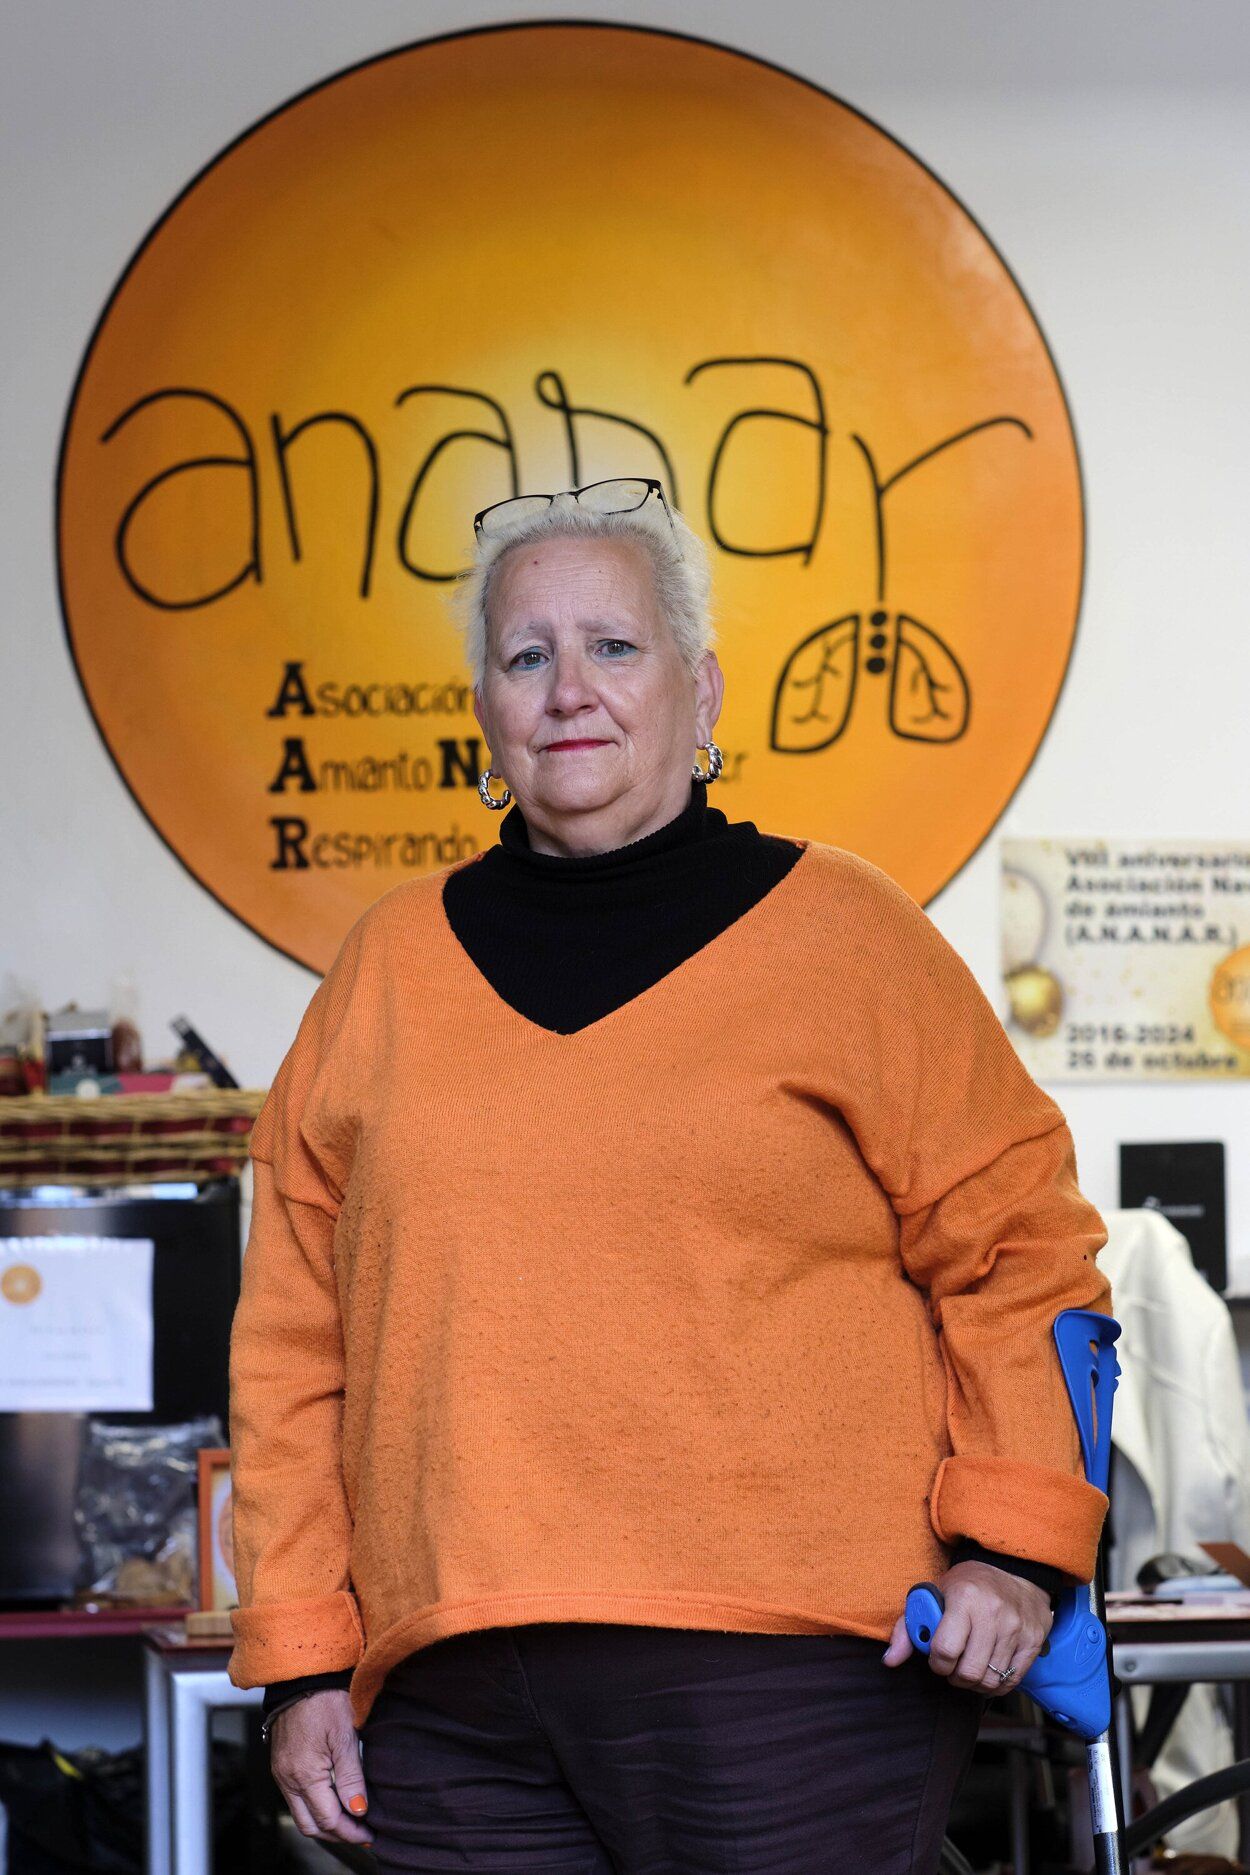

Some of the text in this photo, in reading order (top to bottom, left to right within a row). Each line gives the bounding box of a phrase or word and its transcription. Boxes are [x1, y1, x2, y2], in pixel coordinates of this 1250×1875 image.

[268, 816, 479, 871] Respirando
[1065, 901, 1205, 918] de amianto
[1104, 1052, 1133, 1070] de
[1142, 1052, 1238, 1070] octubre
